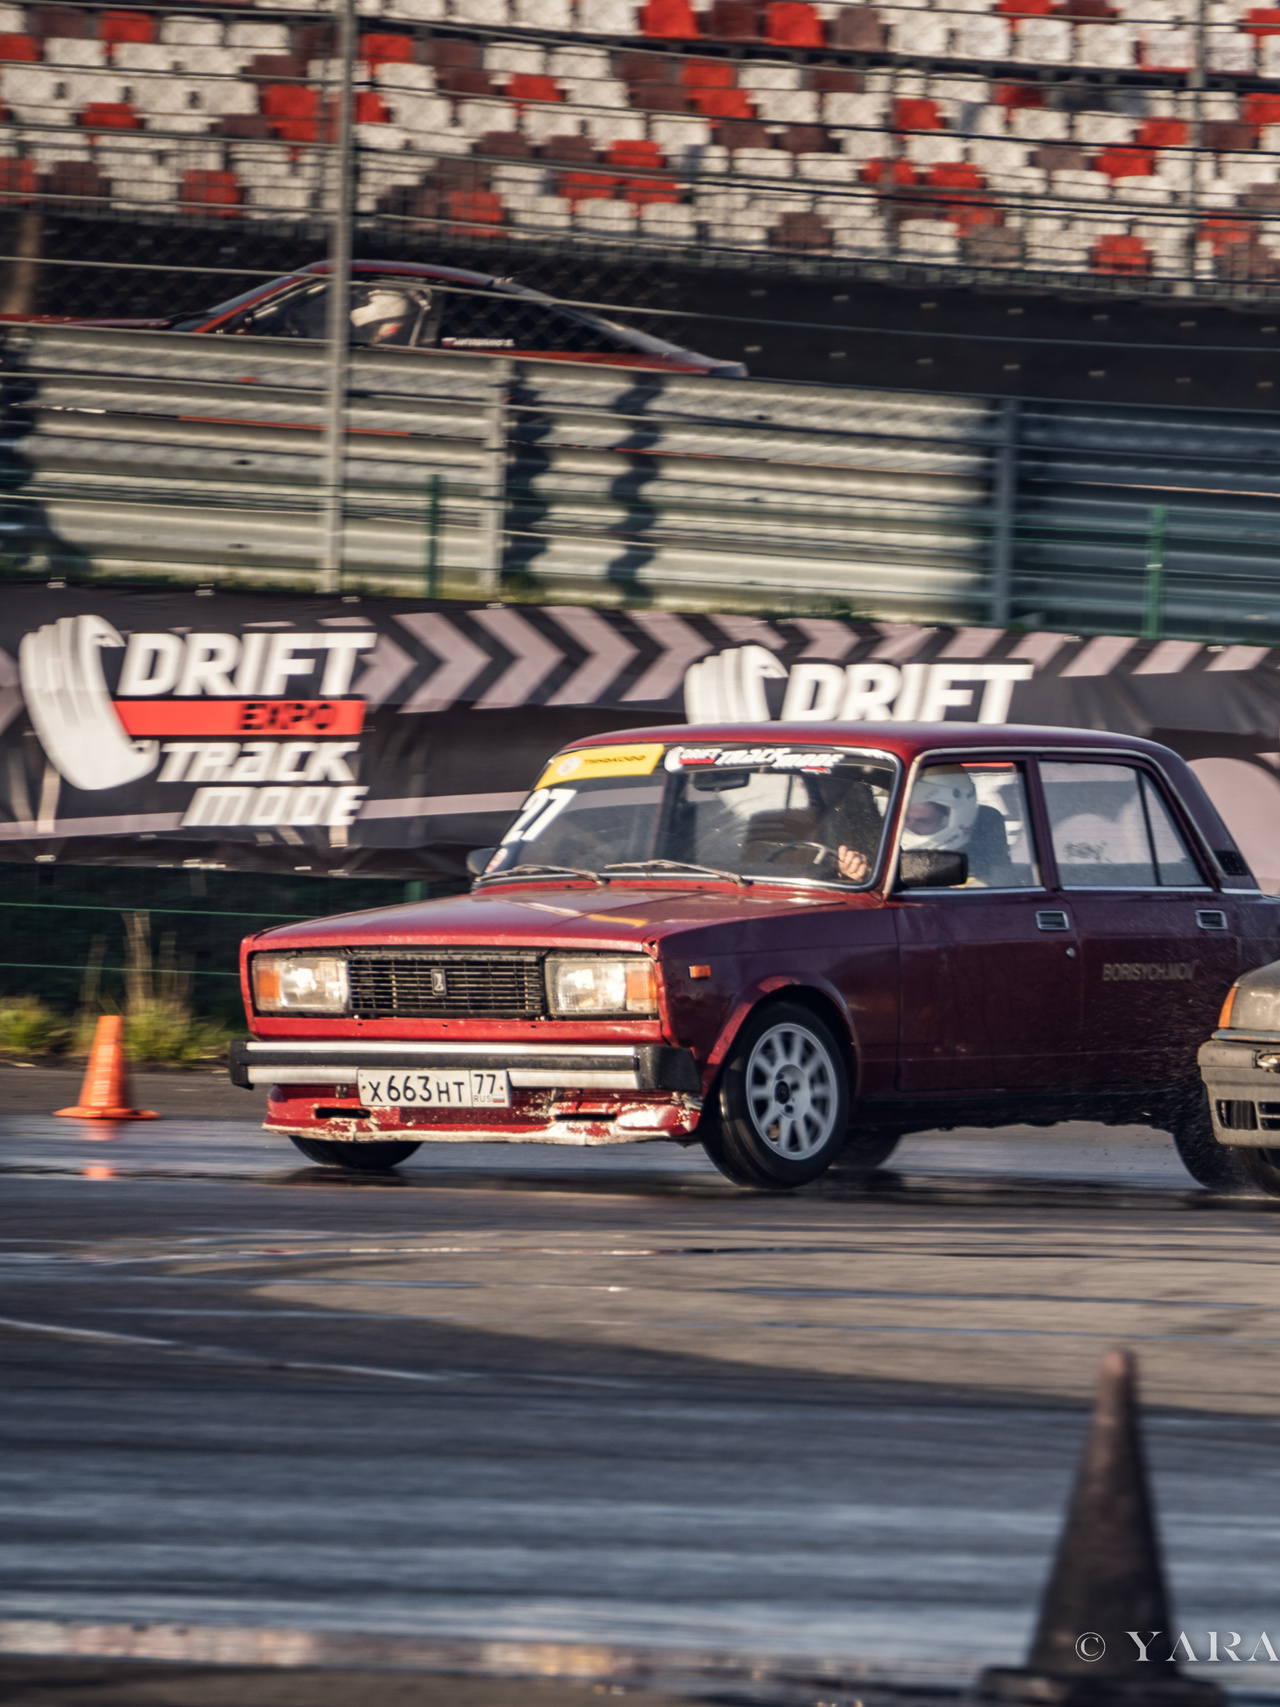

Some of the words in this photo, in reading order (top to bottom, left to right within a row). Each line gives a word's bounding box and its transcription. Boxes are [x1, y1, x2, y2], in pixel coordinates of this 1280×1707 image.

[117, 632, 377, 697] DRIFT
[780, 663, 1034, 723] DRIFT
[238, 703, 337, 731] EXPO
[473, 1073, 496, 1094] 77
[473, 1094, 492, 1103] RUS
